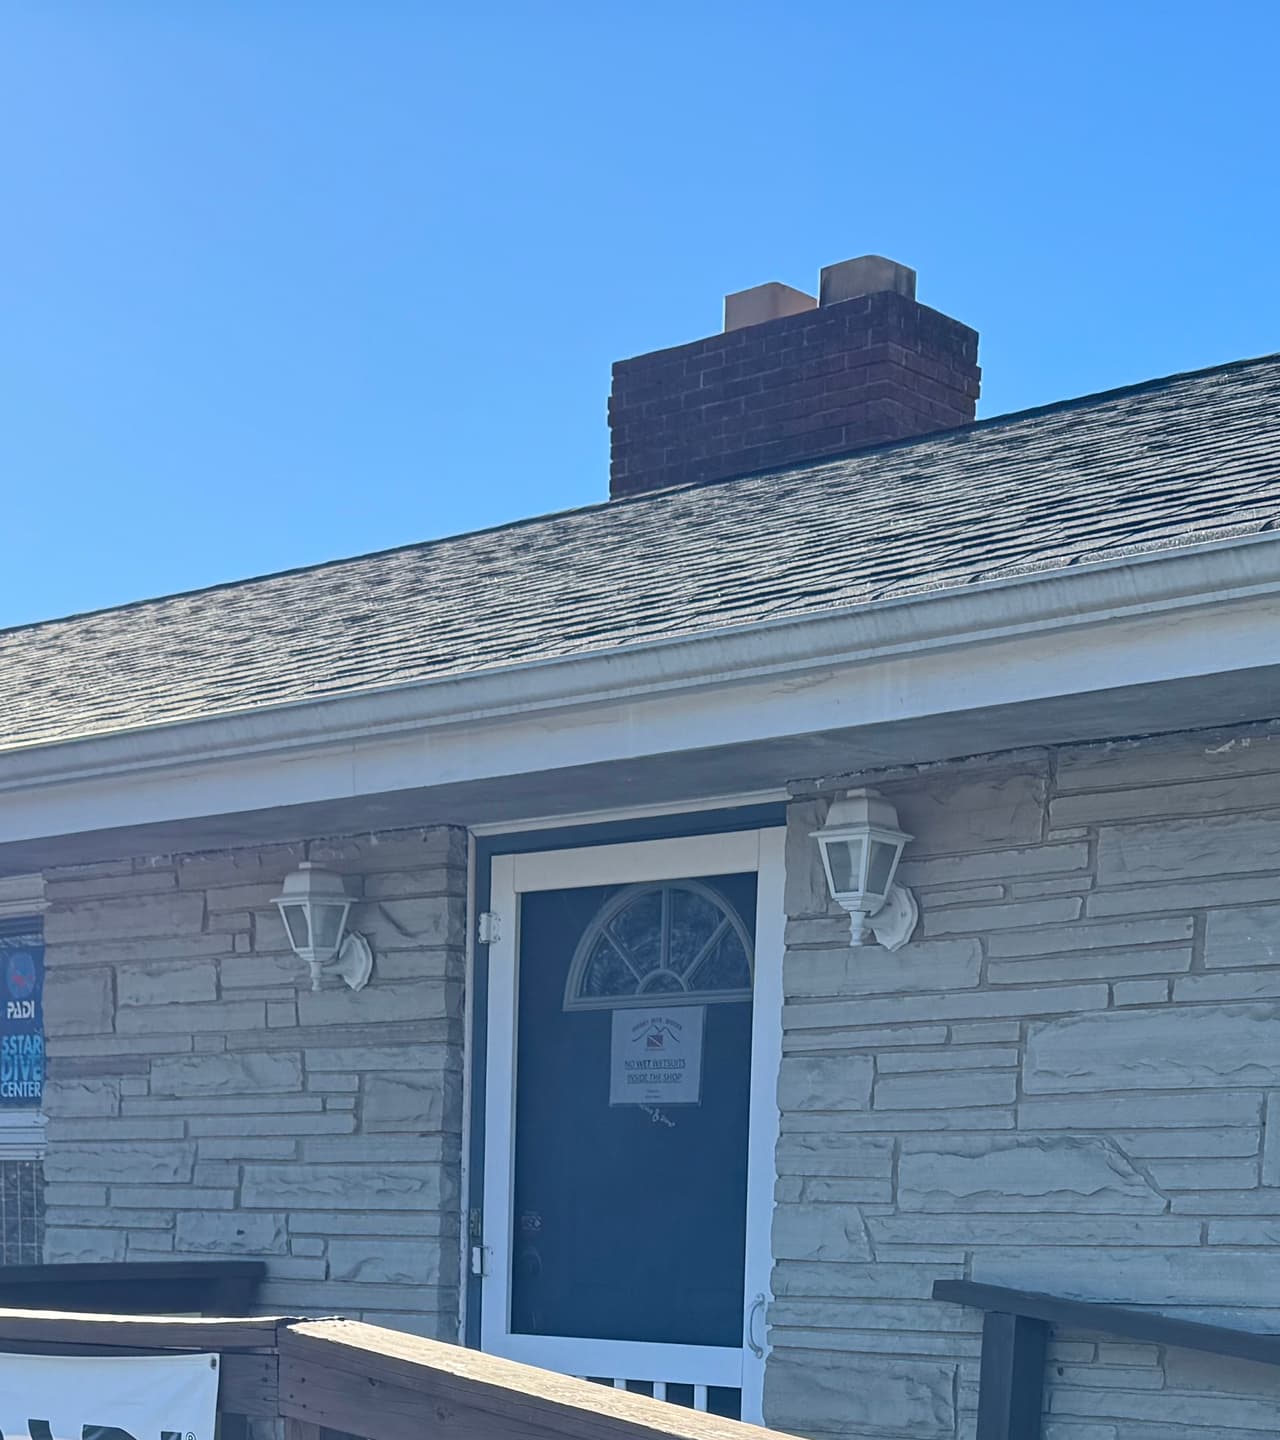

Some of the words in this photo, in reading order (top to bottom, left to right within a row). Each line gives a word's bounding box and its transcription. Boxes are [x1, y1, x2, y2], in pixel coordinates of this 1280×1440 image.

[7, 1000, 35, 1019] PADI
[1, 1055, 42, 1081] DIVE
[1, 1081, 42, 1098] CENTER
